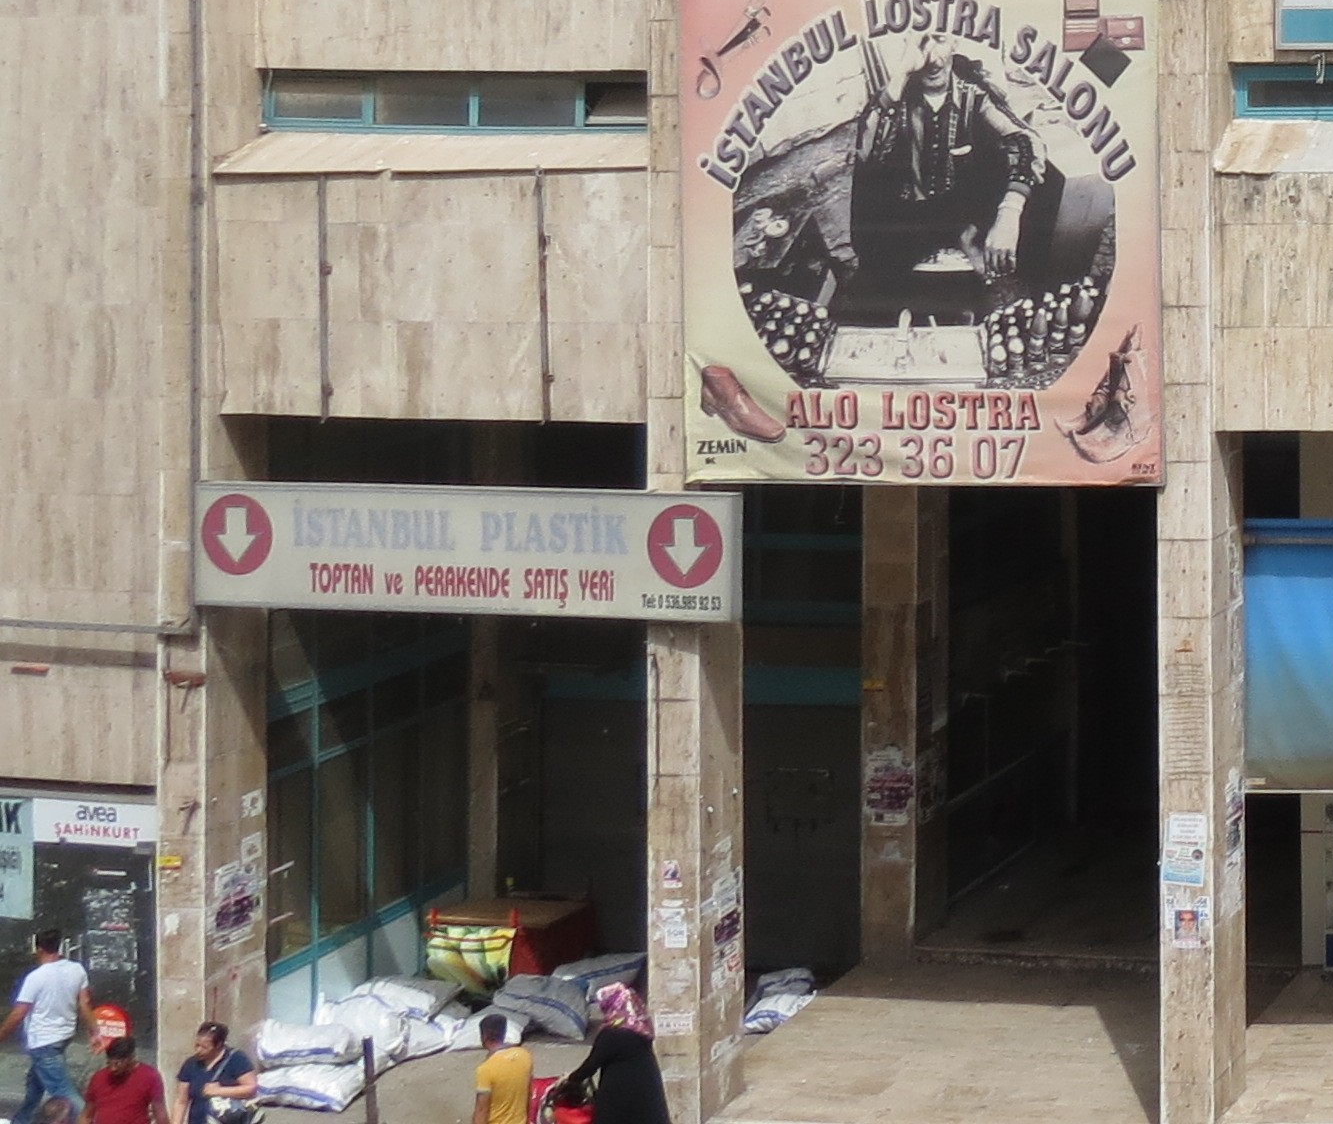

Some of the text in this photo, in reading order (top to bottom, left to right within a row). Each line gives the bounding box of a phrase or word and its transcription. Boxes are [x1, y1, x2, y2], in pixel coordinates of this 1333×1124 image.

[1010, 25, 1137, 182] SALONU
[785, 390, 1041, 431] ALO LOSTRA
[803, 434, 1026, 478] 323 36 07
[292, 499, 629, 556] İSTANBUL PLASTİK
[310, 563, 374, 595] TOPTAN
[384, 572, 404, 595] ve
[414, 565, 511, 599] PERAKENDE
[523, 568, 569, 609] SATIŞ
[0, 801, 22, 834] K
[75, 805, 118, 822] avea
